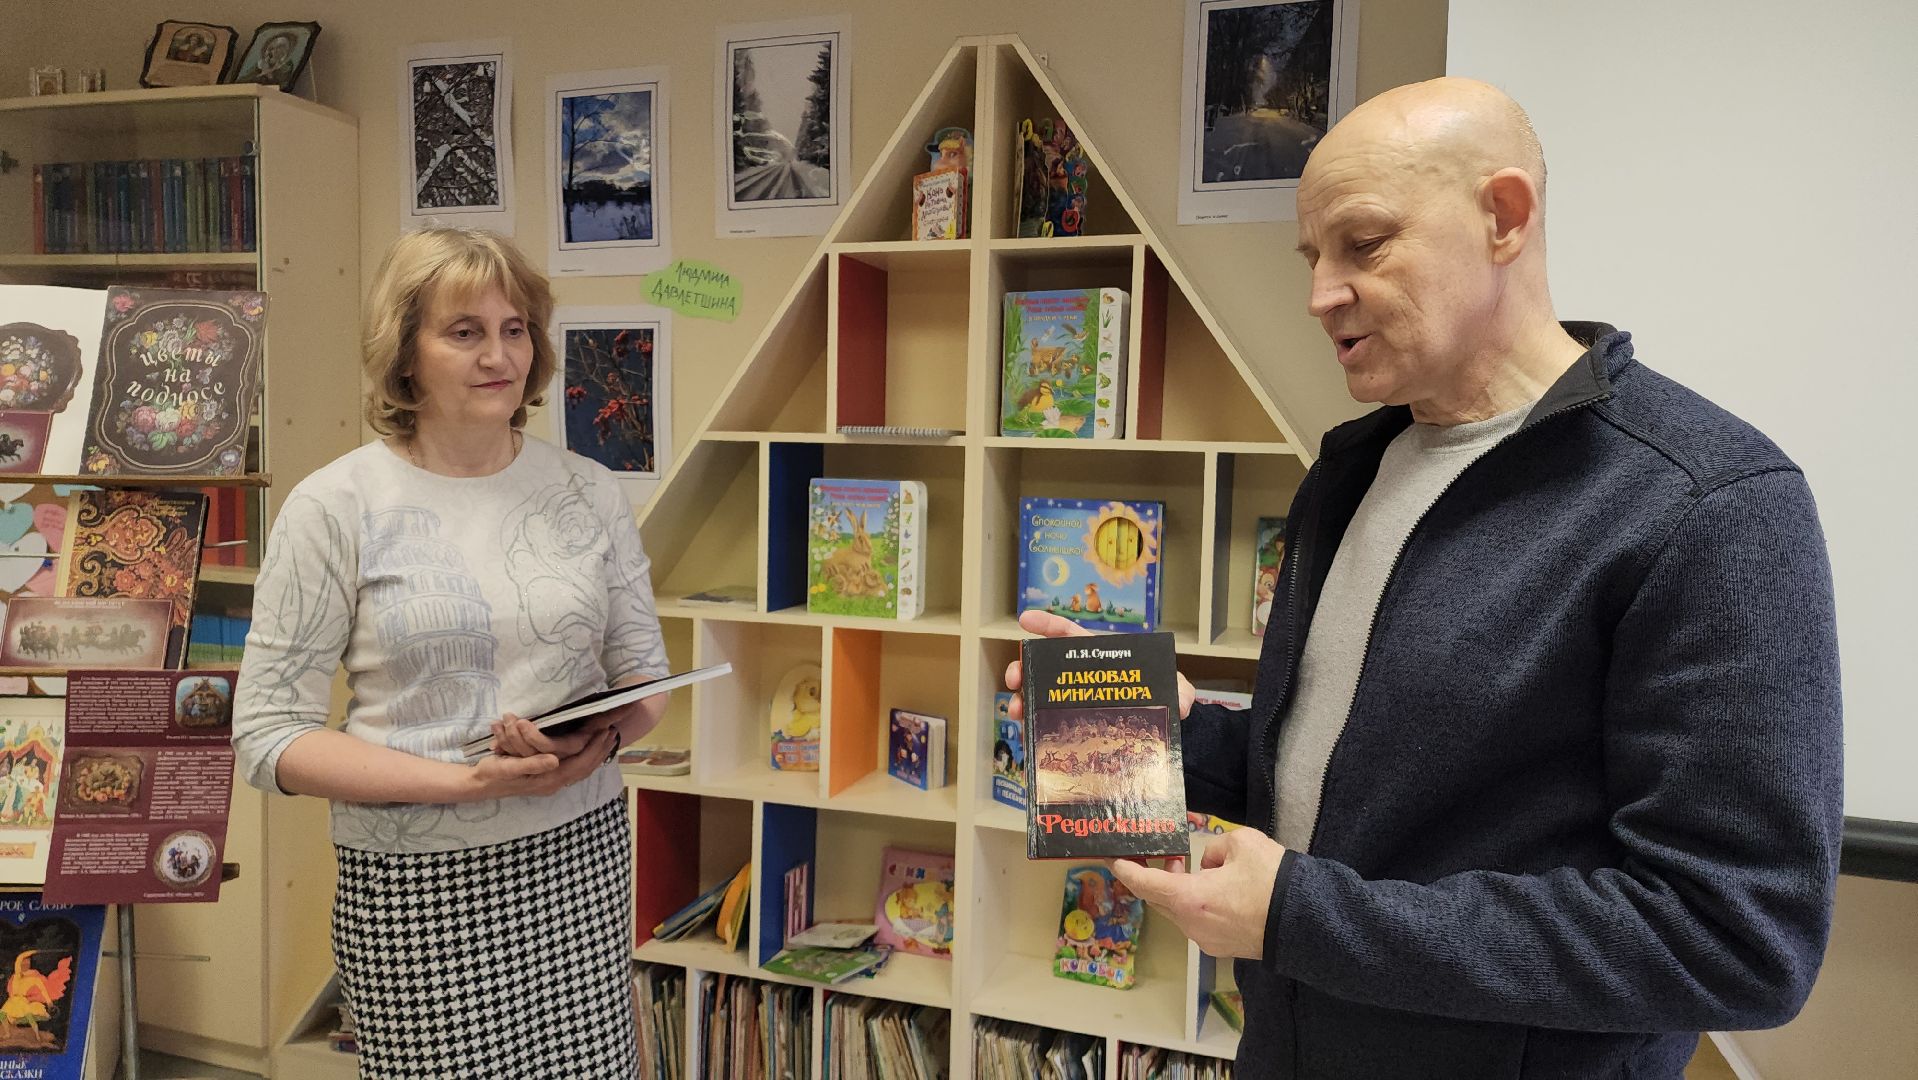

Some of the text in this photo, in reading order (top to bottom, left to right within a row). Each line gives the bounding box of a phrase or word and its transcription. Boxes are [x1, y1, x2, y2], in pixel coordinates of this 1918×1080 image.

[651, 278, 736, 316] ДАВЛЕТШИНА
[139, 347, 221, 367] цветы
[163, 367, 192, 383] на
[126, 380, 226, 406] подносе
[1056, 669, 1142, 685] ЛАКОВАЯ
[1047, 686, 1153, 703] МИНИАТЮРА
[1059, 957, 1124, 983] КОЛОБОК
